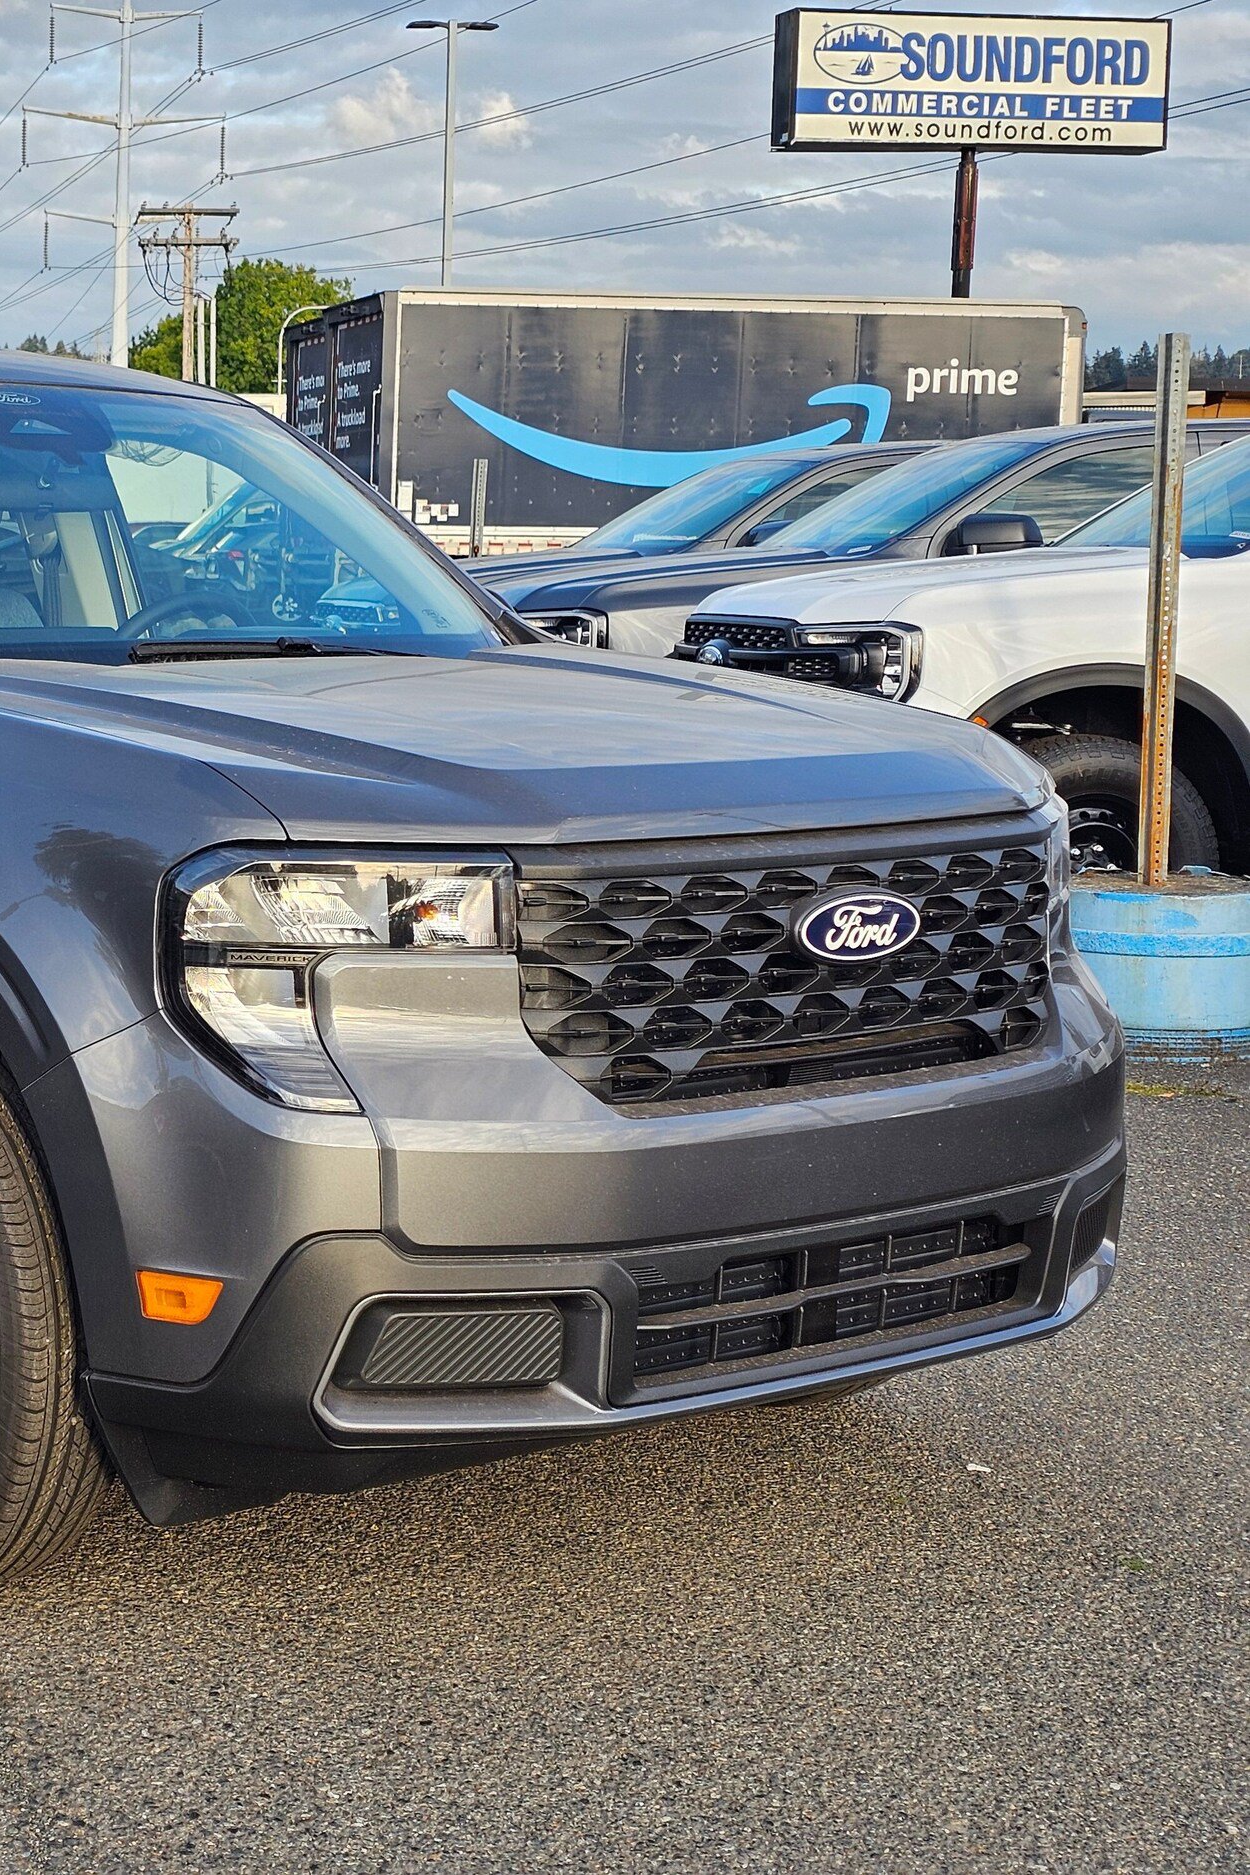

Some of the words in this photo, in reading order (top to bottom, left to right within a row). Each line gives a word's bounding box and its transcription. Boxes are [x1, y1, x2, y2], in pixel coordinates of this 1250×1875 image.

[900, 31, 1150, 87] SOUNDFORD
[826, 90, 1030, 118] COMMERCIAL
[1045, 97, 1134, 121] FLEET
[848, 119, 1113, 142] www.soundford.com
[337, 360, 356, 379] There's
[356, 359, 371, 374] more
[906, 357, 1019, 402] prime
[298, 374, 316, 392] There's
[337, 384, 343, 400] to
[341, 406, 366, 428] truckload
[336, 435, 351, 450] more.
[825, 904, 900, 951] Ford
[230, 954, 312, 963] MAVERICK
